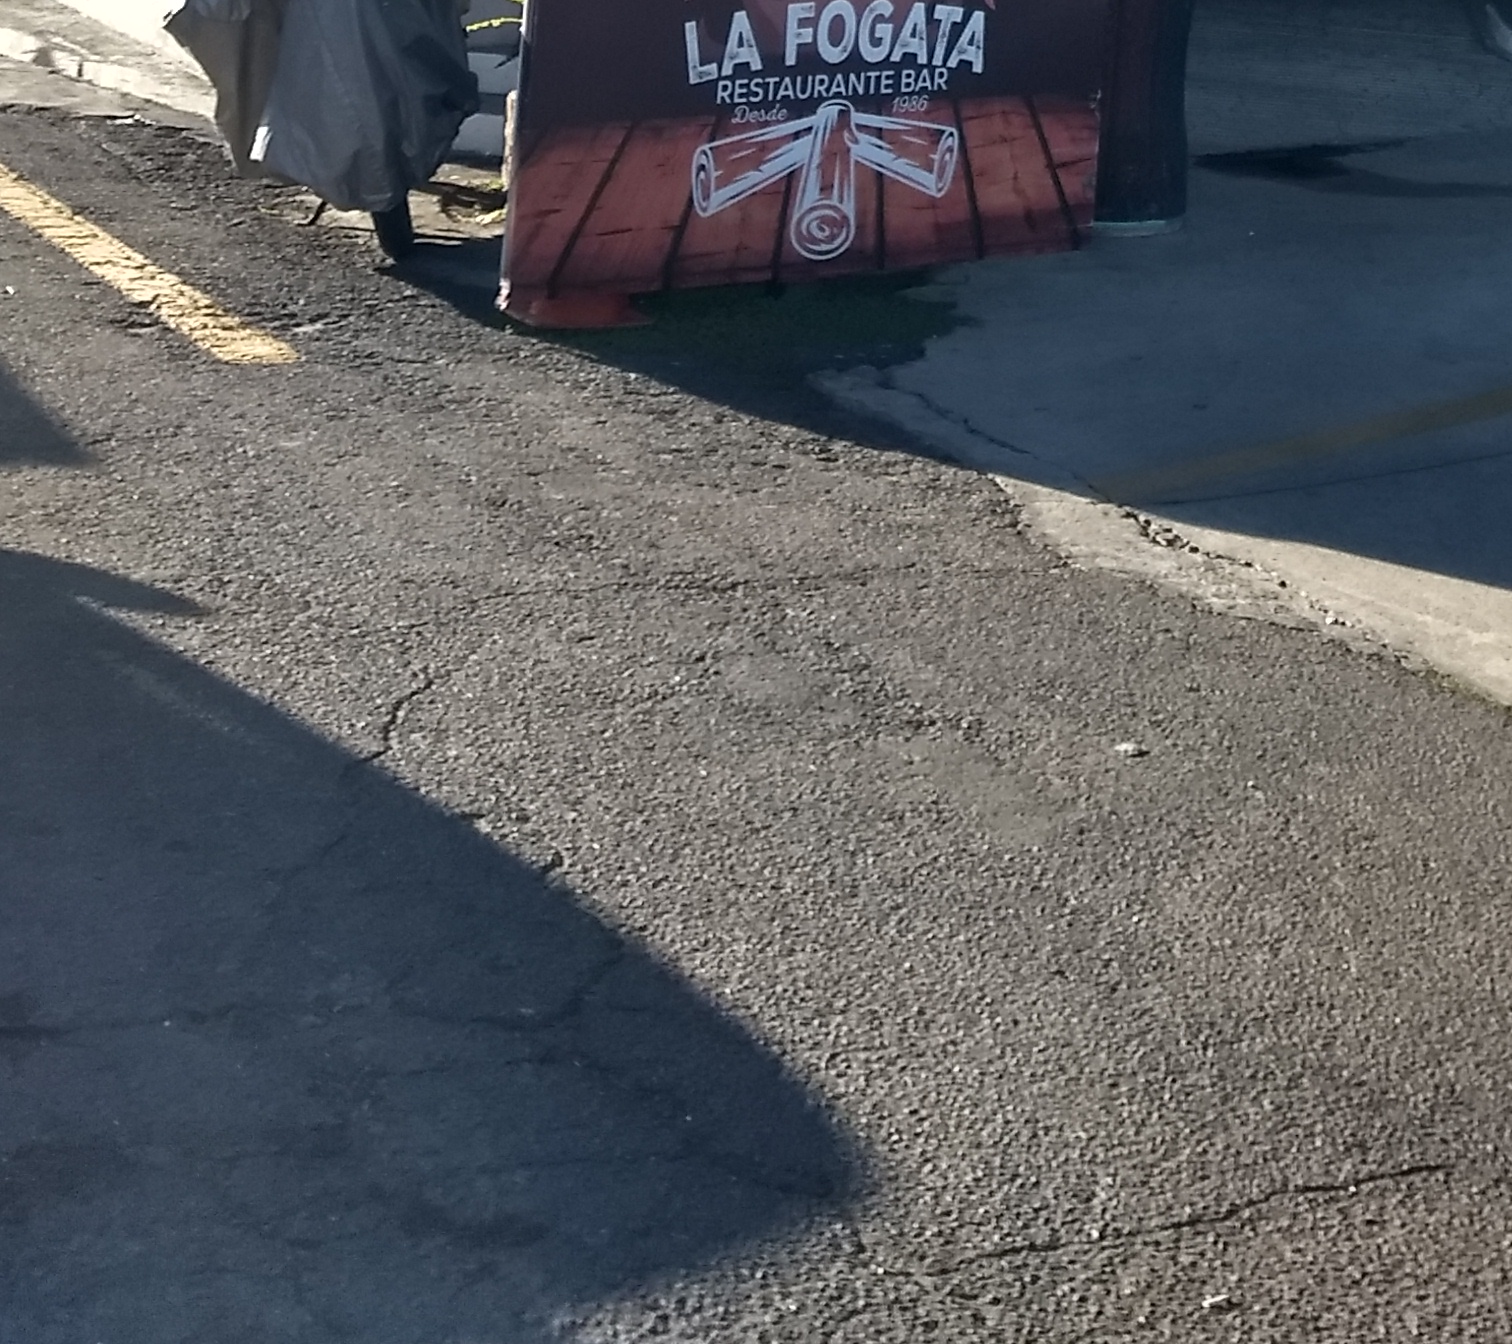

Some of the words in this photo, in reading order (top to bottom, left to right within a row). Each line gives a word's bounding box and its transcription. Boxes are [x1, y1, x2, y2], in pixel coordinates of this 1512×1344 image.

[684, 9, 763, 85] LA
[715, 69, 896, 105] RESTAURANTE
[899, 66, 949, 94] BAR
[730, 103, 788, 124] Desde
[891, 94, 930, 113] 1986
